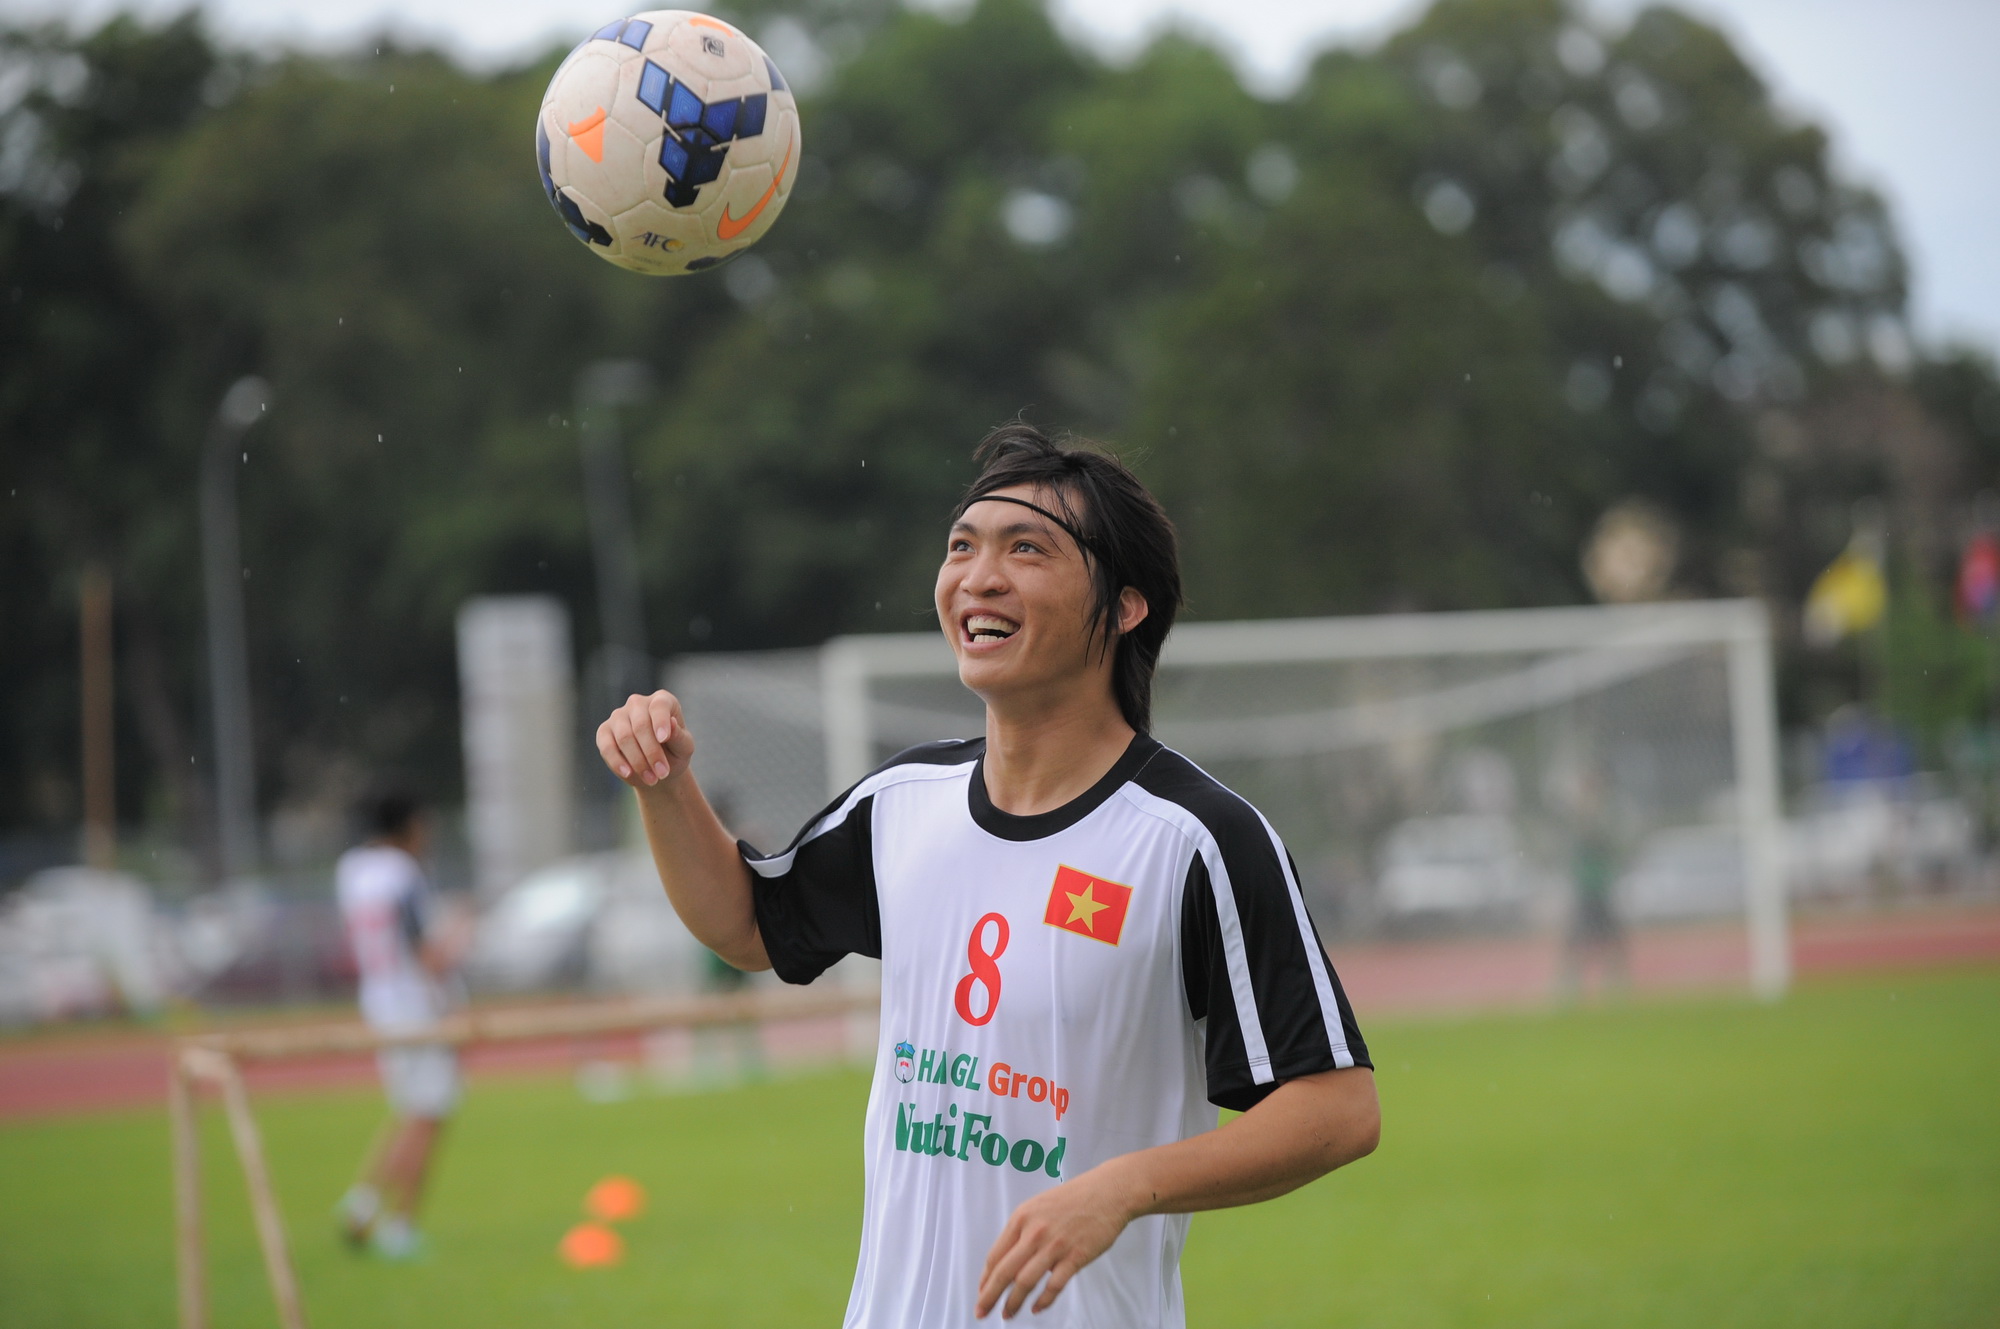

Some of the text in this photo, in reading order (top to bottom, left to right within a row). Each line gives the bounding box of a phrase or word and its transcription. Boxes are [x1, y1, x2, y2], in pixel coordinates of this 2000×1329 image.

[630, 231, 683, 253] AFC
[954, 912, 1010, 1026] 8
[917, 1048, 1069, 1121] HAGL Group
[895, 1102, 1067, 1179] NutiFood
